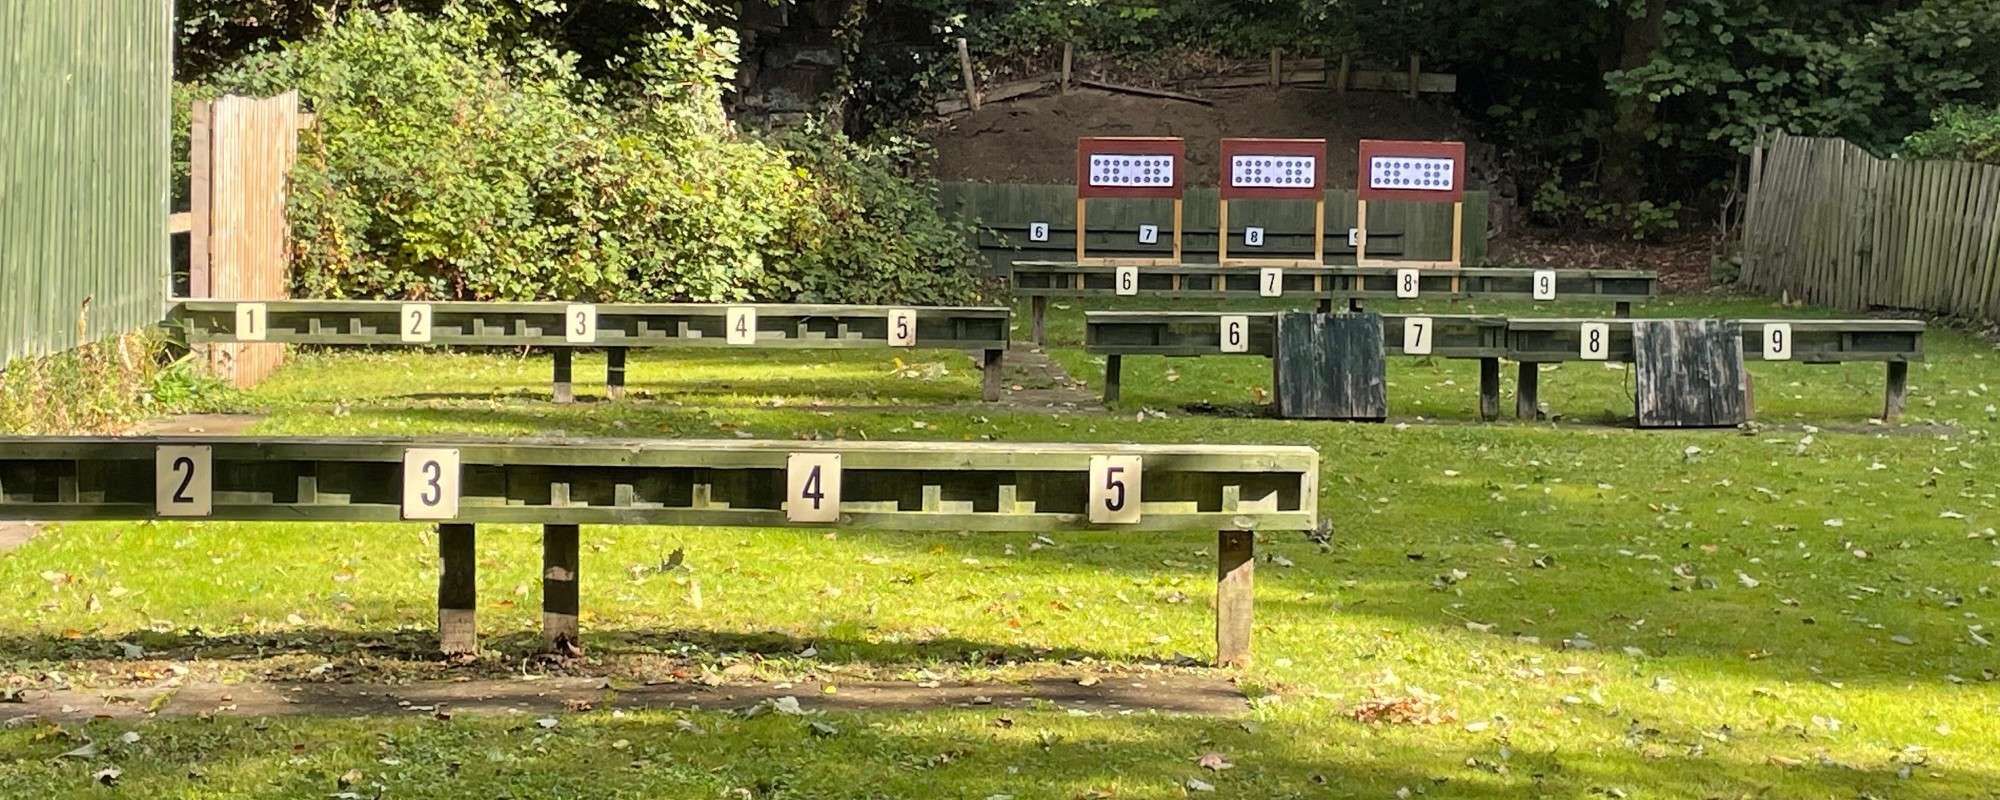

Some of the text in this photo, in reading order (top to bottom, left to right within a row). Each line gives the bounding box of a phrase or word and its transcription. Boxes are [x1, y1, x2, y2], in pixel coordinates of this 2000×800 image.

[1035, 225, 1044, 239] 6
[1145, 228, 1153, 241] 7
[1249, 229, 1258, 243] 8
[1122, 271, 1131, 291] 6
[1267, 272, 1276, 291] 7
[1403, 273, 1412, 293] 8
[1540, 276, 1549, 295] 9
[246, 309, 254, 333] 1
[411, 310, 422, 334] 2
[576, 311, 586, 335] 3
[736, 314, 747, 337] 4
[896, 315, 908, 340] 5
[1229, 321, 1240, 346] 6
[1412, 323, 1423, 348] 7
[1589, 328, 1600, 353] 8
[1772, 329, 1783, 354] 9
[172, 456, 195, 504] 2
[421, 460, 441, 507] 3
[802, 465, 825, 510] 4
[1104, 467, 1125, 512] 5
